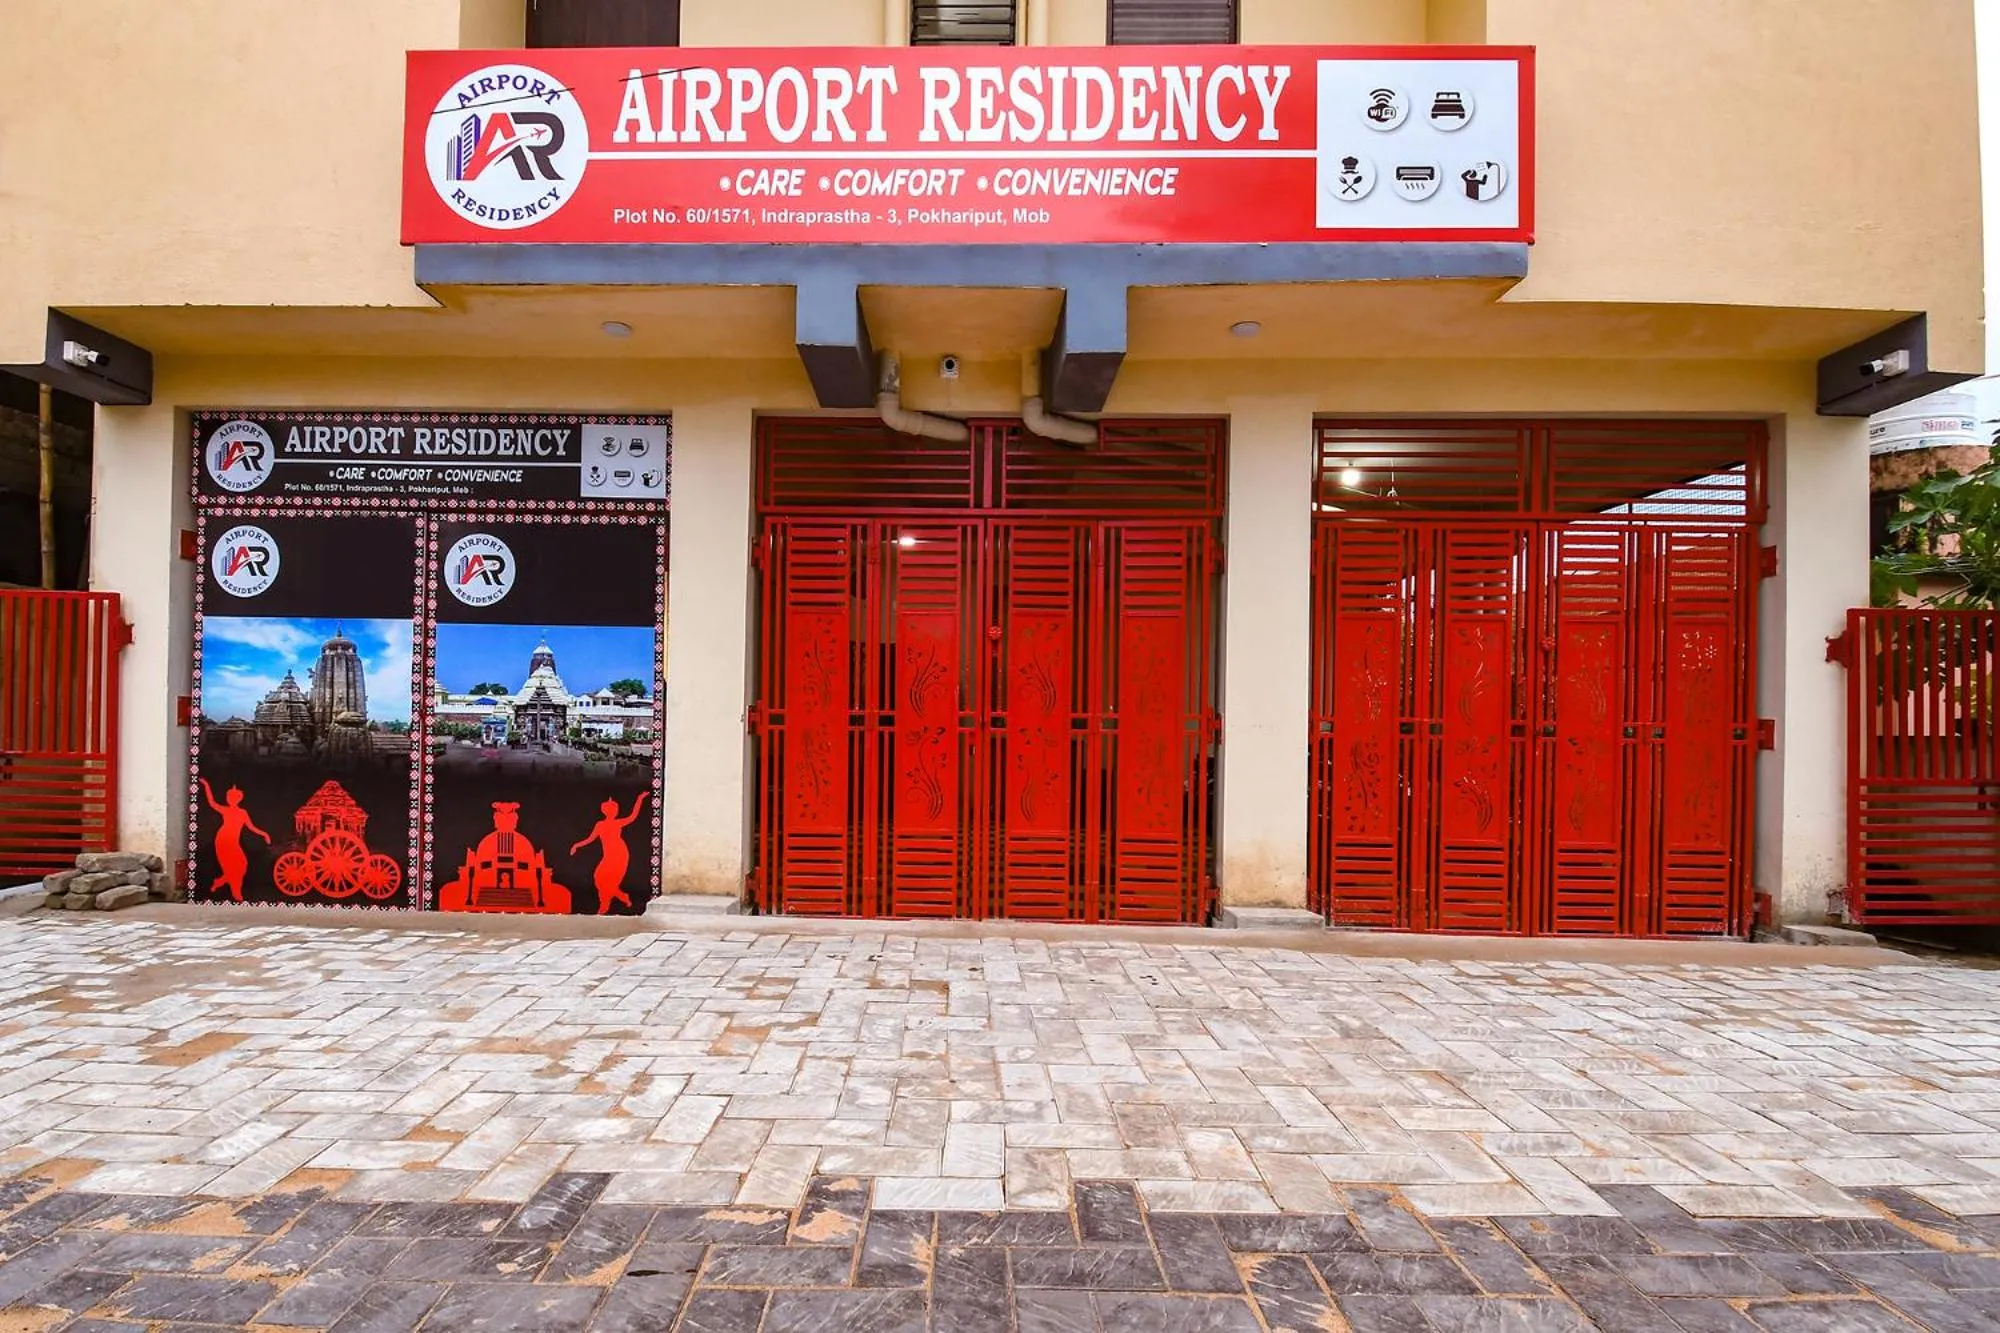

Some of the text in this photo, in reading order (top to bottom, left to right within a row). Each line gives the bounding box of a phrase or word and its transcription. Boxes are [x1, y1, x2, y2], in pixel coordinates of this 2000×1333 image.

[456, 74, 561, 108] AIRPORT
[612, 64, 1291, 144] AIRPORT RESIDENCY
[735, 167, 1180, 197] CARE COMFORT CONVENIENCE
[450, 187, 561, 221] RESIDENCY
[613, 208, 648, 224] Plot
[652, 208, 681, 224] No.
[685, 208, 756, 227] 60/1571,
[761, 208, 871, 228] Indraprastha
[887, 208, 902, 227] 3,
[907, 208, 1007, 228] Pokhariput,
[1012, 208, 1050, 224] Mob
[219, 423, 264, 440] AIRPORT
[284, 425, 571, 457] AIRPORT RESIDENCY
[217, 473, 263, 489] RESIDENCY
[335, 467, 523, 483] CARE COMFORT CONVENIENCE
[284, 483, 299, 491] Plot
[301, 483, 314, 492] No.
[225, 530, 269, 545] AIRPORT
[458, 537, 503, 553] AIRPORT
[222, 579, 267, 594] RESIDENCY
[456, 588, 503, 603] RESIDENCY
